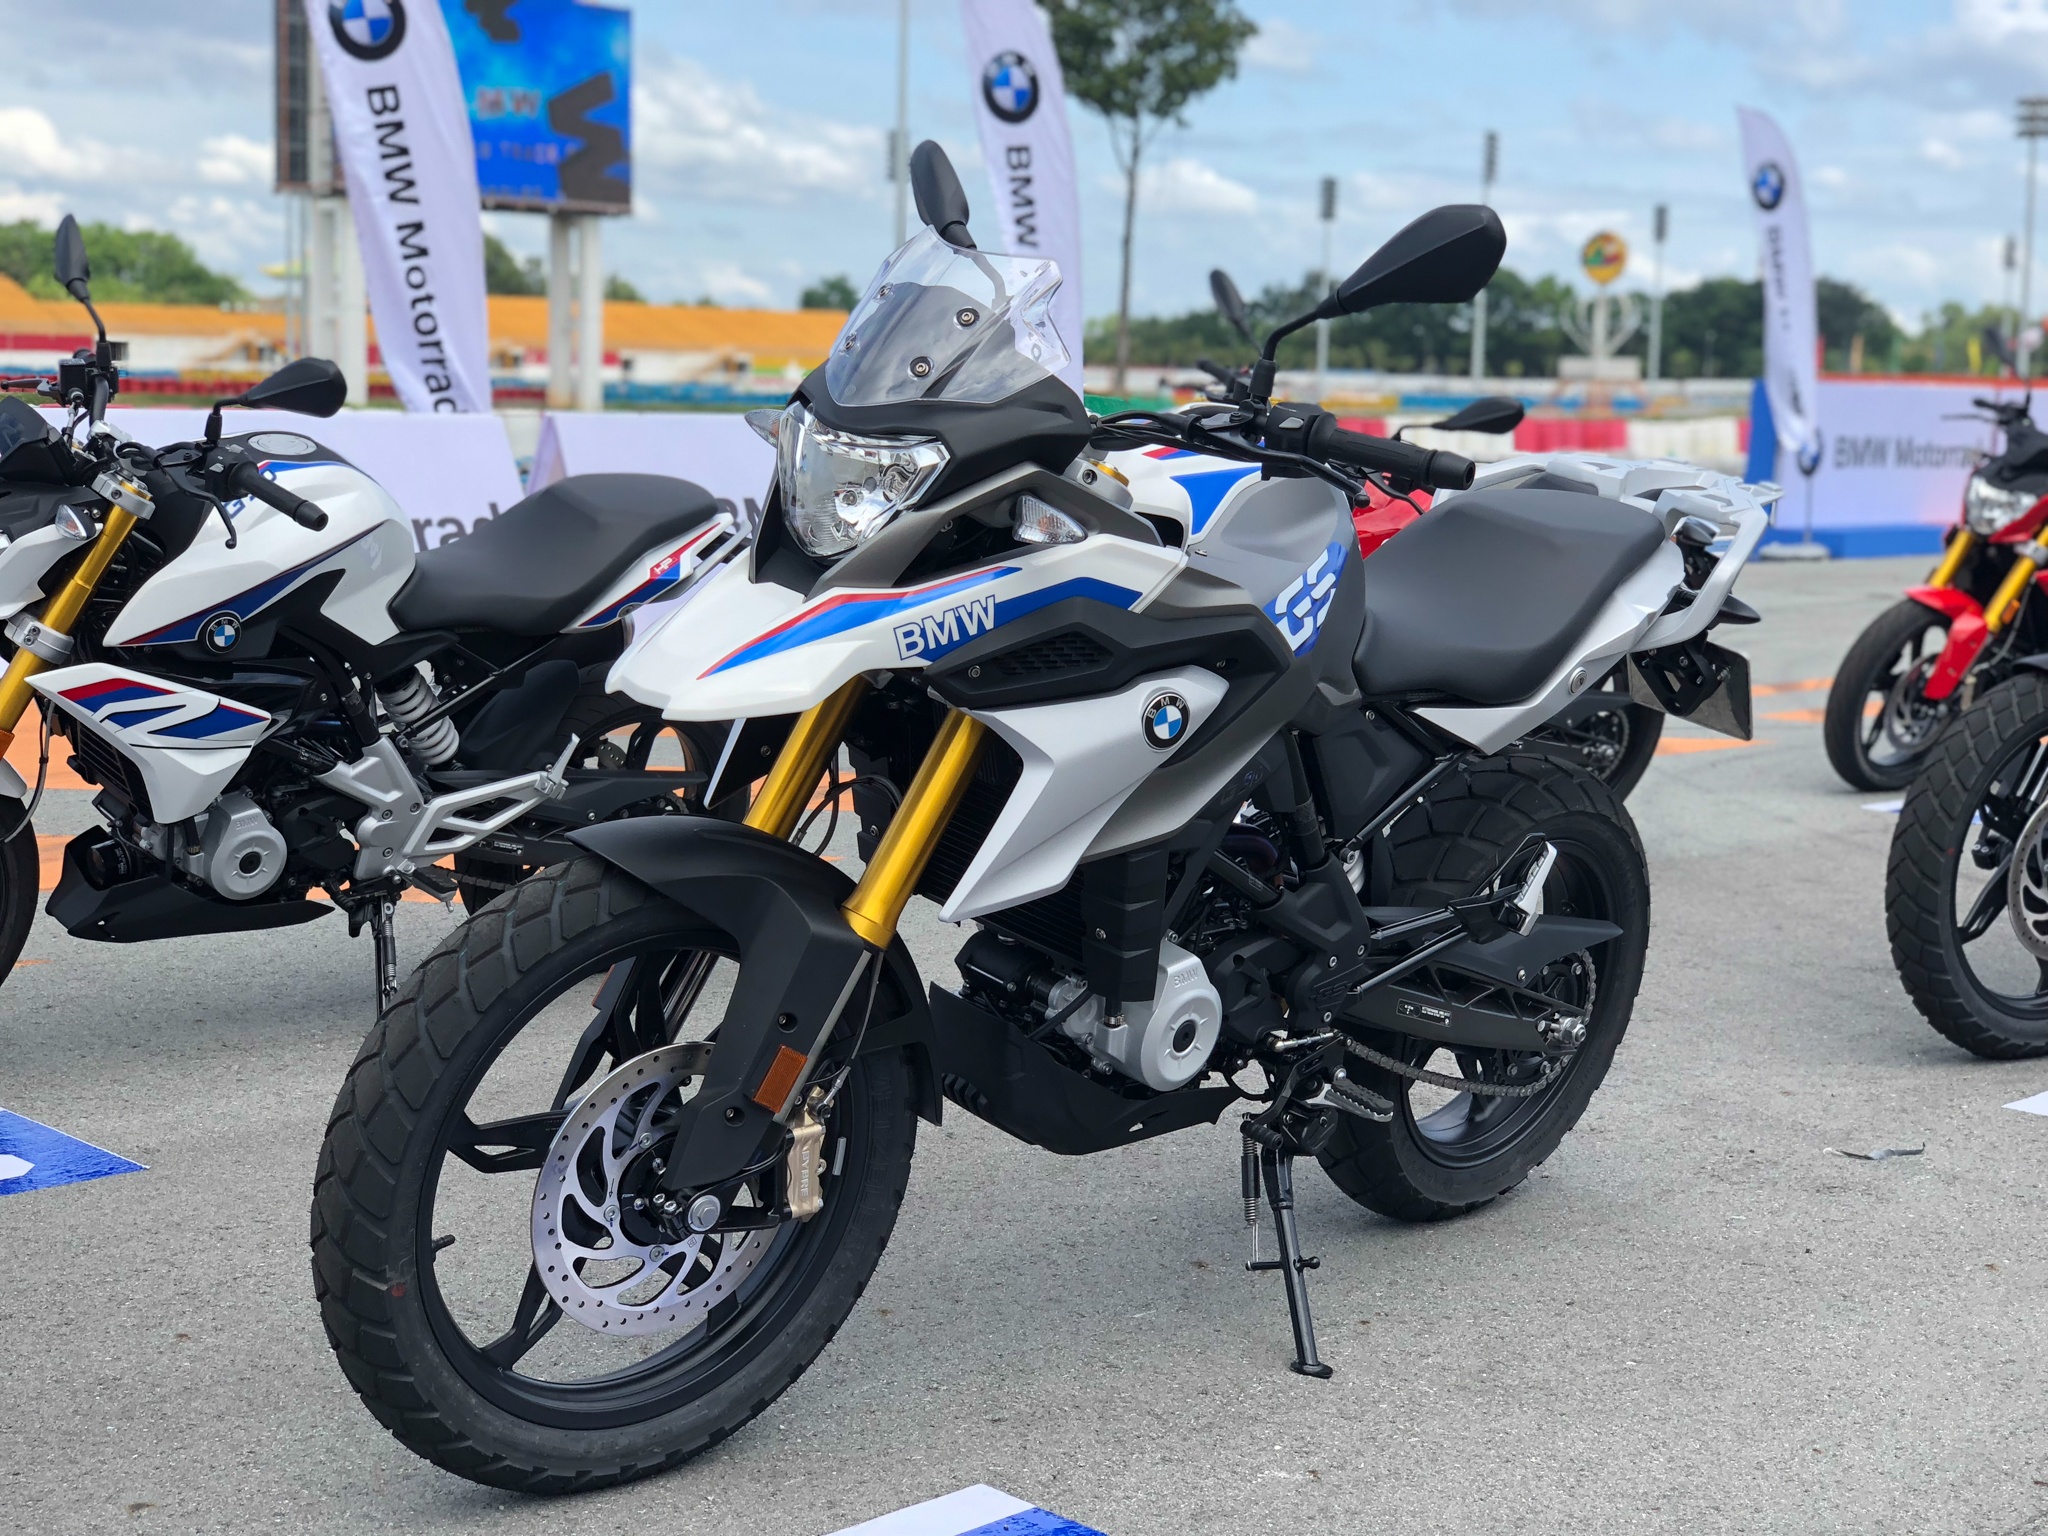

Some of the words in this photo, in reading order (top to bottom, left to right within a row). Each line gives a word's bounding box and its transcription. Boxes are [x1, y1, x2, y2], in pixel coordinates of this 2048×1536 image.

[366, 84, 420, 205] BMW
[1005, 145, 1038, 248] BMW
[653, 557, 677, 574] HP
[893, 594, 995, 661] BMW
[1275, 548, 1336, 651] GS
[1147, 696, 1185, 719] BMW
[1173, 966, 1198, 988] BMW
[800, 1150, 810, 1198] BYBRE
